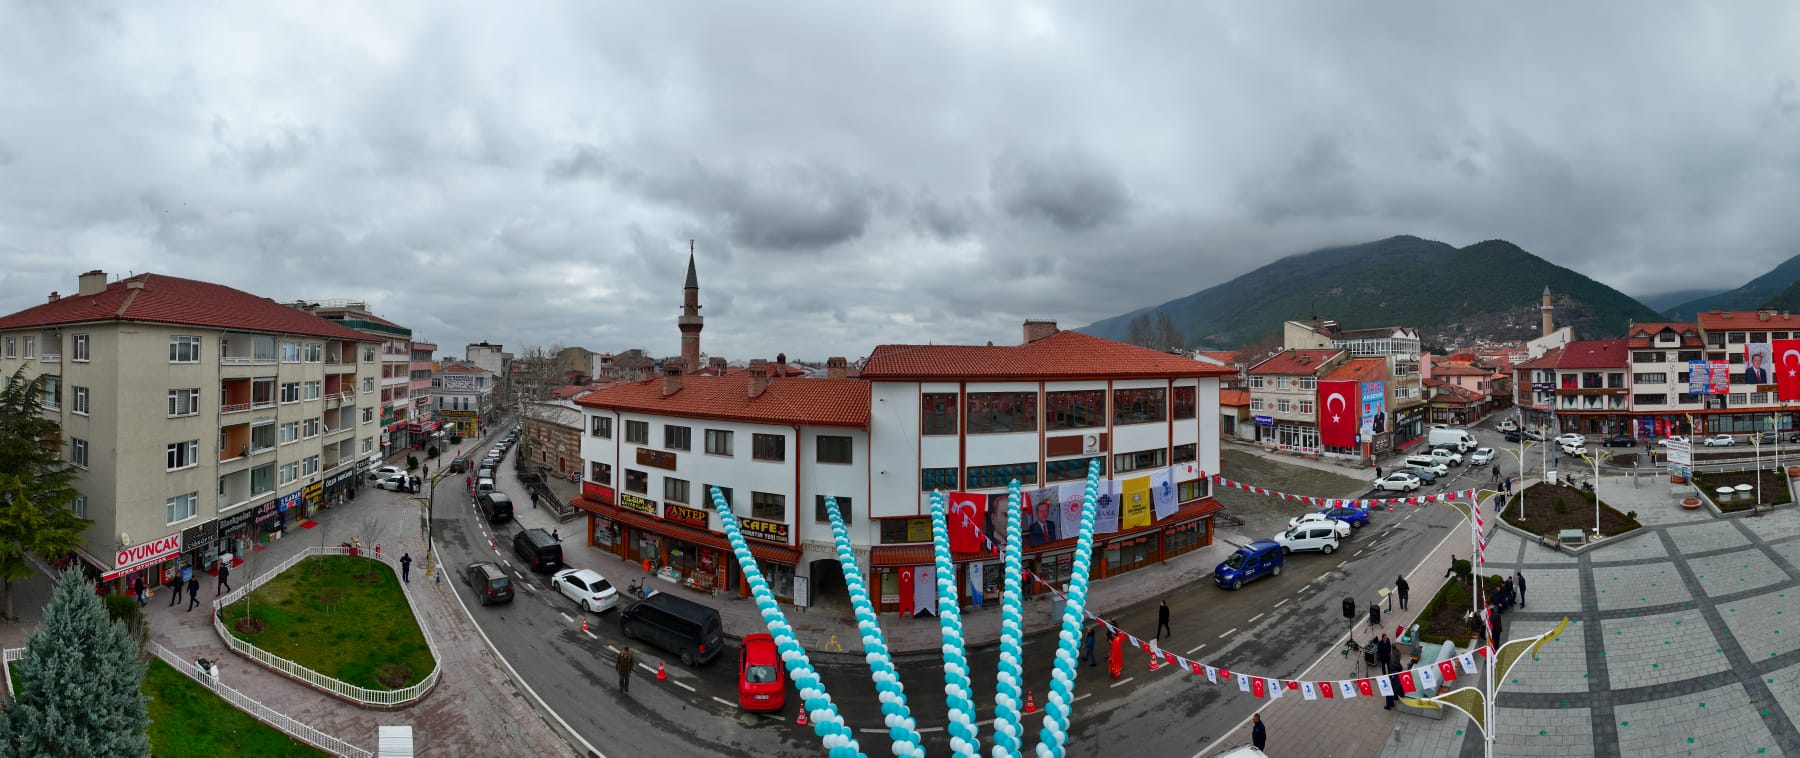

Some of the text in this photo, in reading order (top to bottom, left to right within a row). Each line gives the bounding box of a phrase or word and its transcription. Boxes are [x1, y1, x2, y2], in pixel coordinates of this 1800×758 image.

[671, 506, 706, 520] ANTEP
[742, 519, 778, 533] CAFE
[117, 535, 180, 566] OYUNCAK
[136, 557, 167, 570] OYUNCAK
